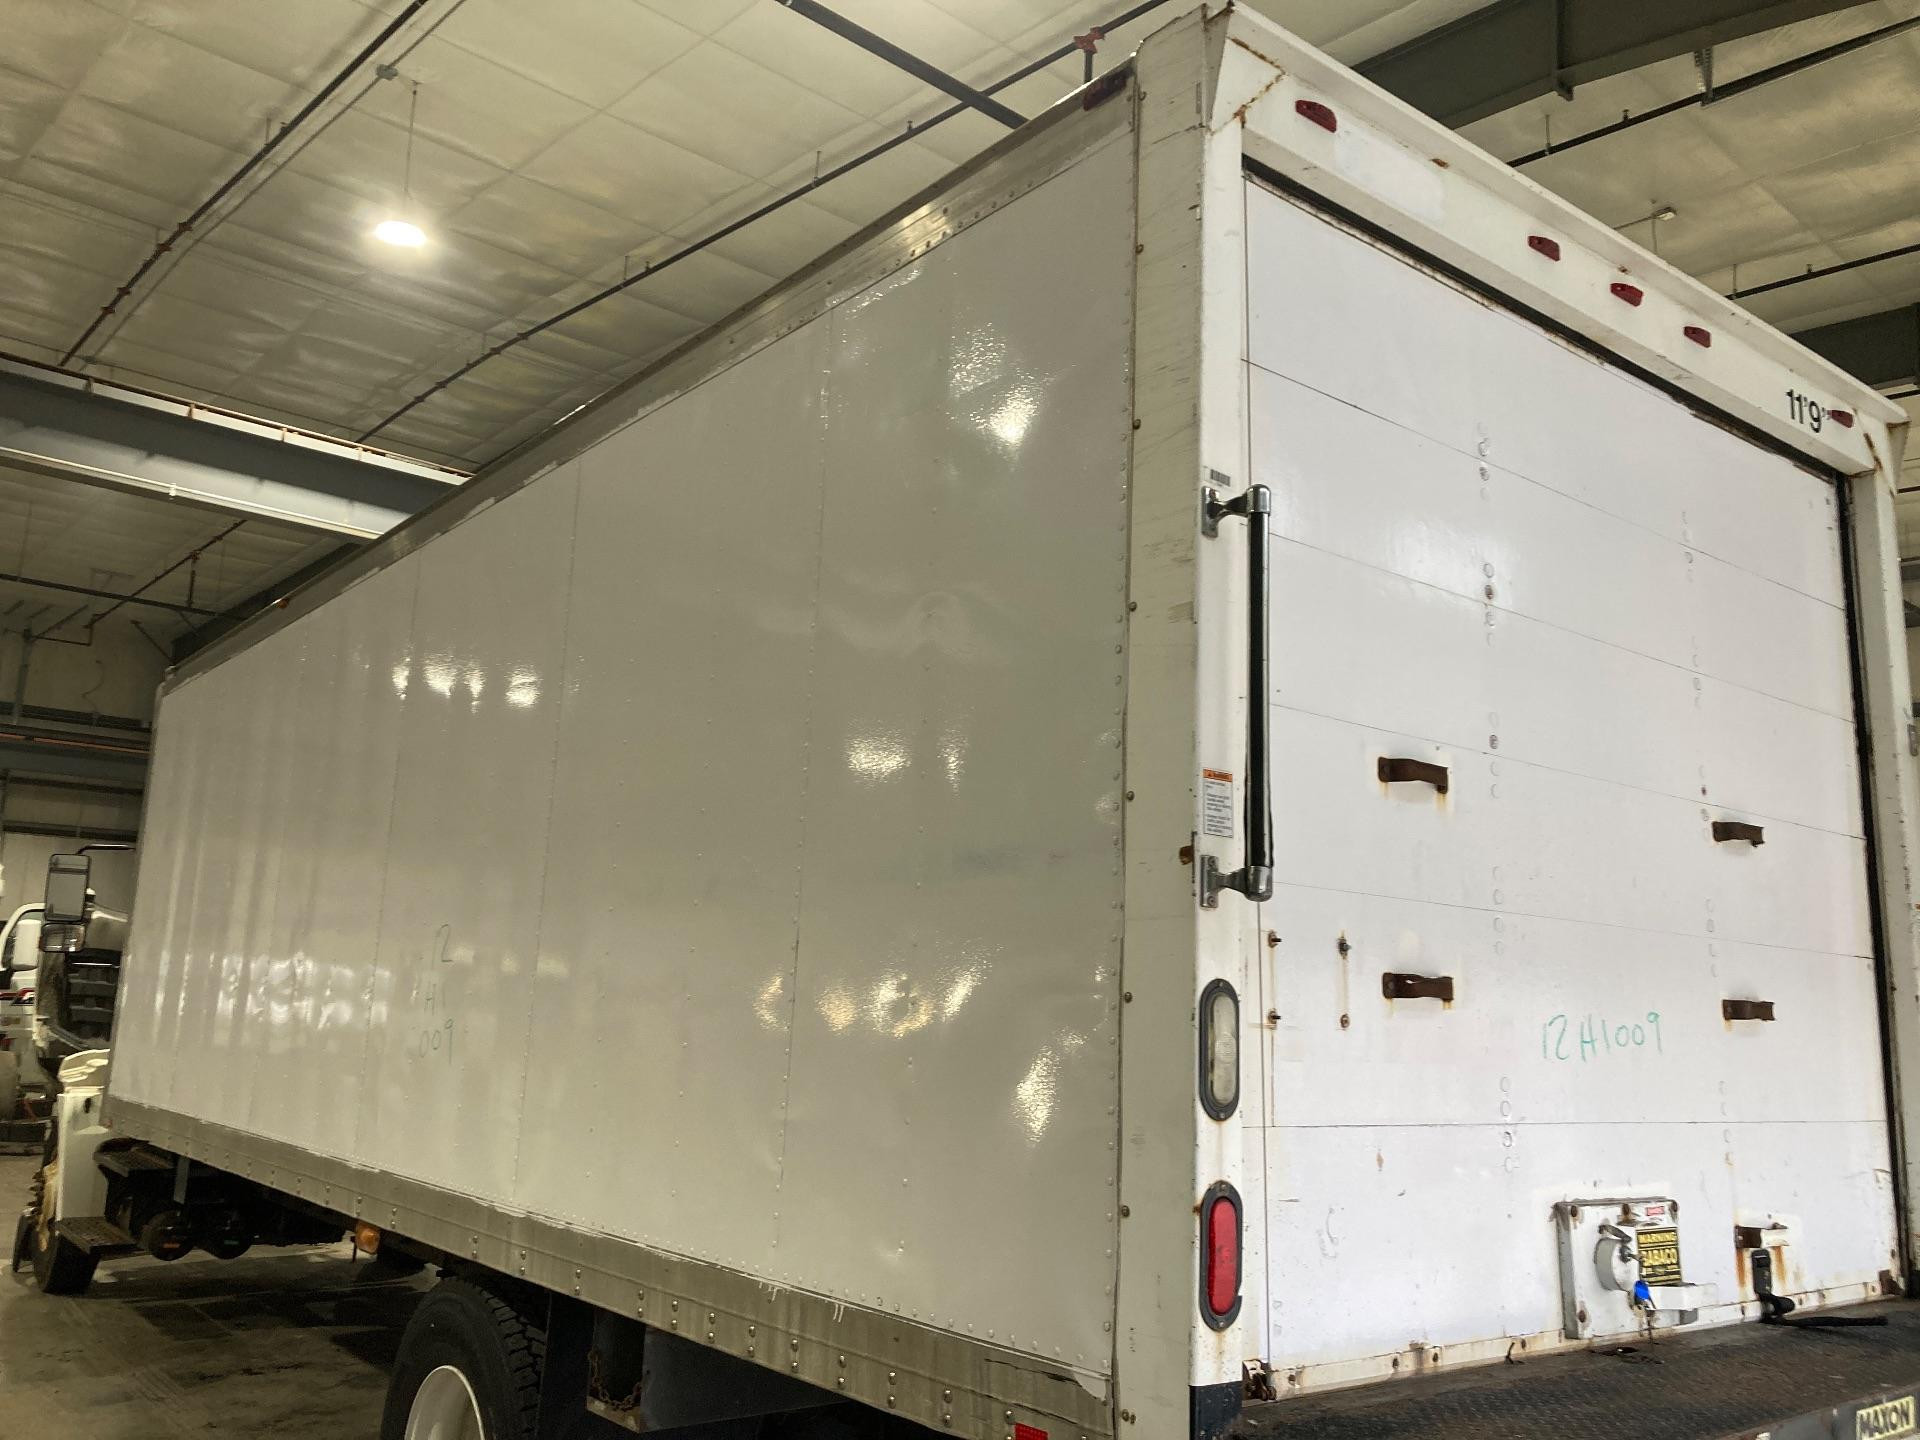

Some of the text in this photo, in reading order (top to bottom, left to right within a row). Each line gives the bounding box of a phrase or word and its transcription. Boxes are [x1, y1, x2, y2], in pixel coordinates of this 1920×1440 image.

[1542, 1011, 1662, 1062] 12H1009
[1638, 1231, 1678, 1245] WARNING
[1859, 1400, 1910, 1438] MAXON
